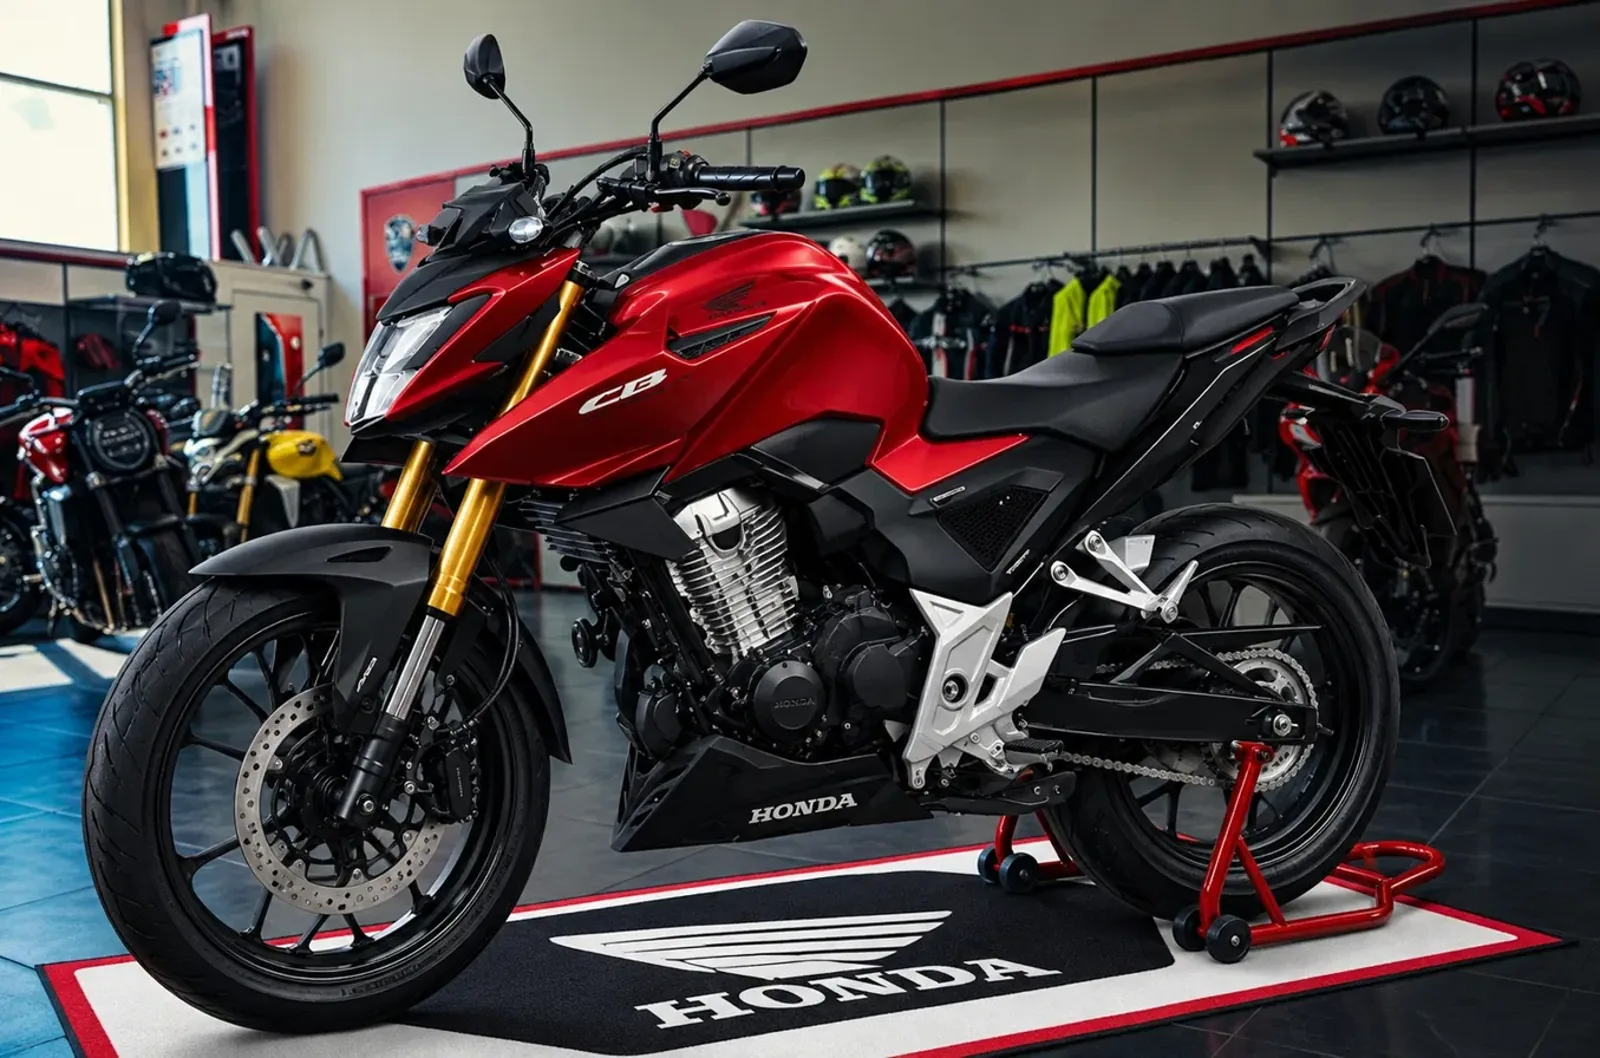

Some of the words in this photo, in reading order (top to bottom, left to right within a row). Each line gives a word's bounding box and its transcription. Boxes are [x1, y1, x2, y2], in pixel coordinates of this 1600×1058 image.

[578, 368, 668, 415] CB
[748, 793, 858, 824] HONDA
[633, 957, 1064, 1029] HONDA
